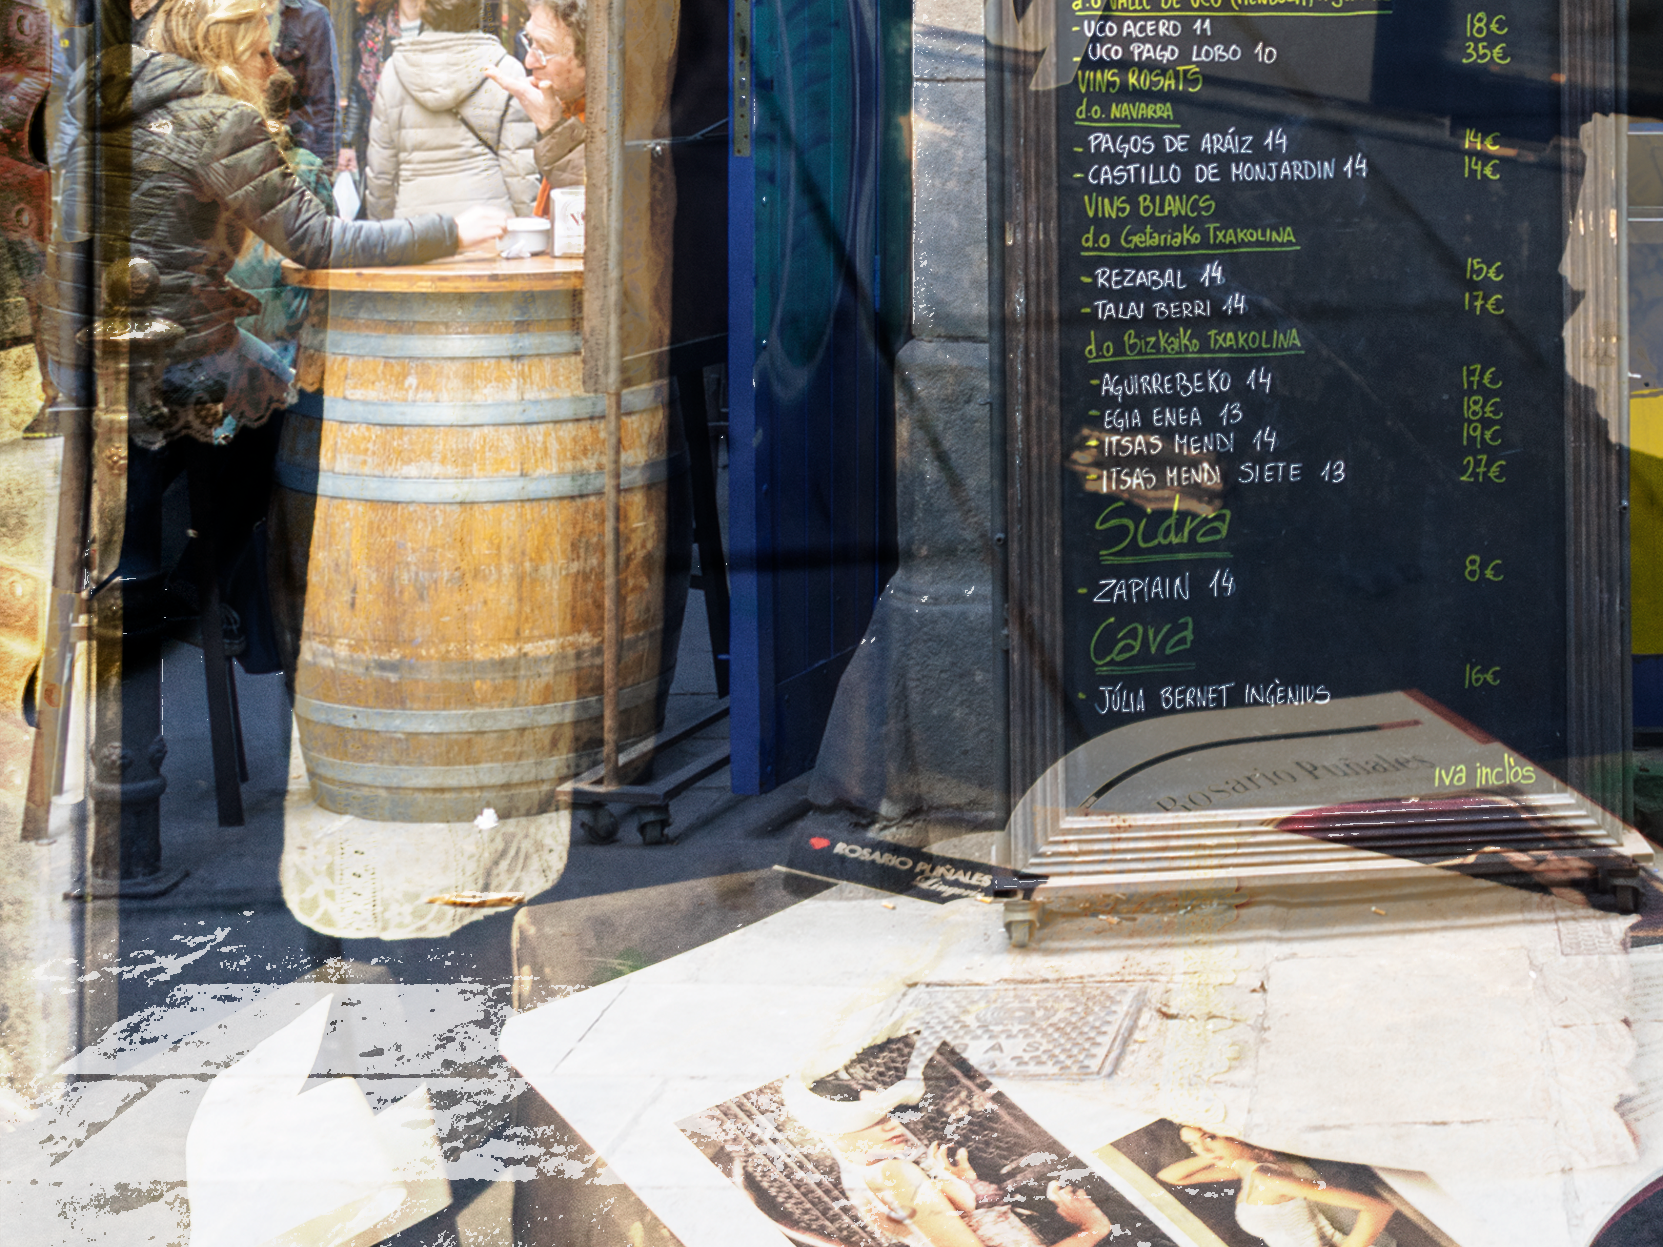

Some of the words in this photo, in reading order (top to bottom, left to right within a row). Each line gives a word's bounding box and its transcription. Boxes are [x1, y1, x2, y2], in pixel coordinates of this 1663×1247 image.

[1083, 20, 1117, 37] UCO
[1122, 19, 1181, 37] ACERO
[1192, 18, 1211, 36] 11
[1088, 43, 1122, 61] UCO
[1130, 43, 1179, 63] PAGO
[1192, 43, 1241, 62] LOBO
[1255, 41, 1277, 64] 10
[1462, 41, 1511, 64] 35€
[1077, 69, 1120, 93] VINS
[1129, 65, 1203, 92] ROSATS
[1111, 101, 1173, 120] NAVARRA
[1088, 132, 1154, 158] PAGOS
[1163, 134, 1190, 152] DE
[1201, 127, 1253, 154] ARÁIZ
[1264, 127, 1287, 153] 14
[1465, 128, 1500, 151] 14€
[1088, 164, 1181, 185] CASTILLO
[1196, 164, 1221, 182] DE
[1232, 158, 1334, 182] MONJARDIN
[1343, 152, 1367, 179] 14
[1465, 156, 1500, 180] 14€
[1084, 192, 1130, 218] VINS
[1139, 194, 1216, 217] BLANCS
[1205, 223, 1296, 244] TXAKOLINA
[1095, 267, 1187, 290] REZABAL
[1201, 260, 1225, 288] 14
[1466, 257, 1504, 281] 15€
[1152, 299, 1211, 318] BERRI
[1223, 292, 1248, 315] 14
[1465, 291, 1504, 315] 17€
[1208, 328, 1301, 350] TXAKOLINA
[1102, 369, 1231, 402] AGUIRREBEKO
[1247, 366, 1271, 394] 14
[1463, 364, 1502, 390] 17€
[1104, 409, 1141, 432] EGIA
[1153, 407, 1202, 427] ENEA
[1219, 402, 1243, 425] 13
[1464, 395, 1503, 420] 18€
[1104, 433, 1162, 457] ITSAS
[1175, 432, 1234, 454] MENDI
[1253, 426, 1279, 452] 14
[1463, 422, 1501, 449] 19€
[1102, 465, 1156, 493] ITSAS
[1166, 462, 1221, 486] MENDI
[1238, 462, 1302, 483] SIETE
[1320, 460, 1346, 483] 13
[1460, 454, 1506, 483] 27€
[1095, 494, 1231, 554] Sidra
[1093, 572, 1189, 604] ZAPIAIN
[1209, 567, 1235, 597] 14
[1090, 616, 1194, 665] Cava
[1464, 663, 1501, 689] 16€
[1094, 681, 1145, 714] JÚLIA
[1161, 681, 1235, 710] BERNET
[833, 841, 913, 870] ROSARIO
